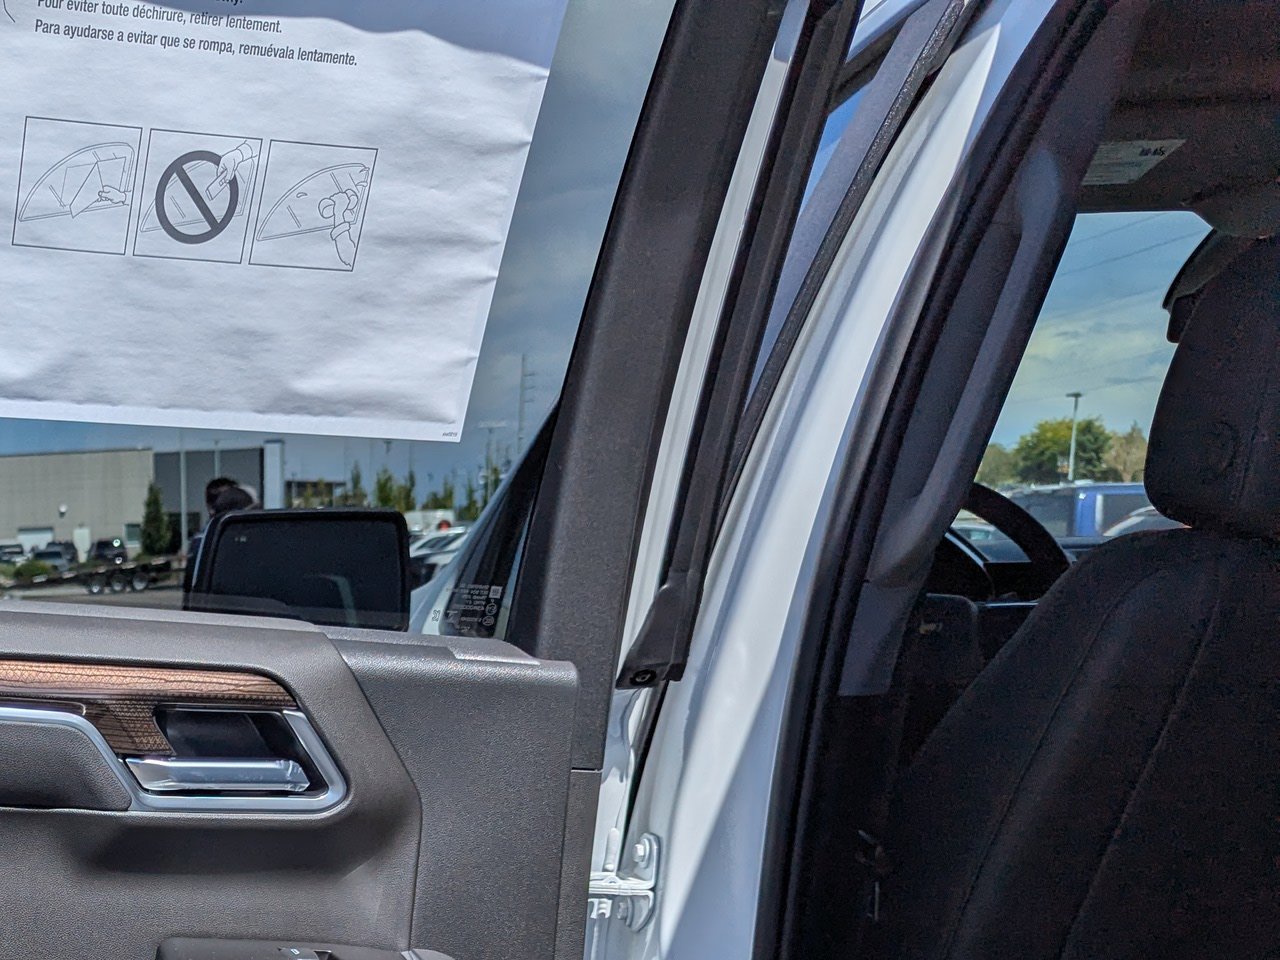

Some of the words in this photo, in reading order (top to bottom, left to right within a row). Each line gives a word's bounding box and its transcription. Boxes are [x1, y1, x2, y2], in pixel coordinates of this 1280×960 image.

[102, 3, 129, 16] toute
[133, 5, 186, 24] déchirure,
[190, 12, 222, 26] retirer
[225, 14, 282, 33] lentement.
[35, 19, 60, 35] Para
[63, 24, 114, 40] ayudarse
[117, 30, 124, 42] a
[127, 30, 158, 45] evitar
[160, 35, 180, 49] que
[183, 38, 195, 49] se
[198, 39, 235, 55] rompa,
[238, 43, 294, 60] remuévala
[297, 47, 357, 66] lentamente.
